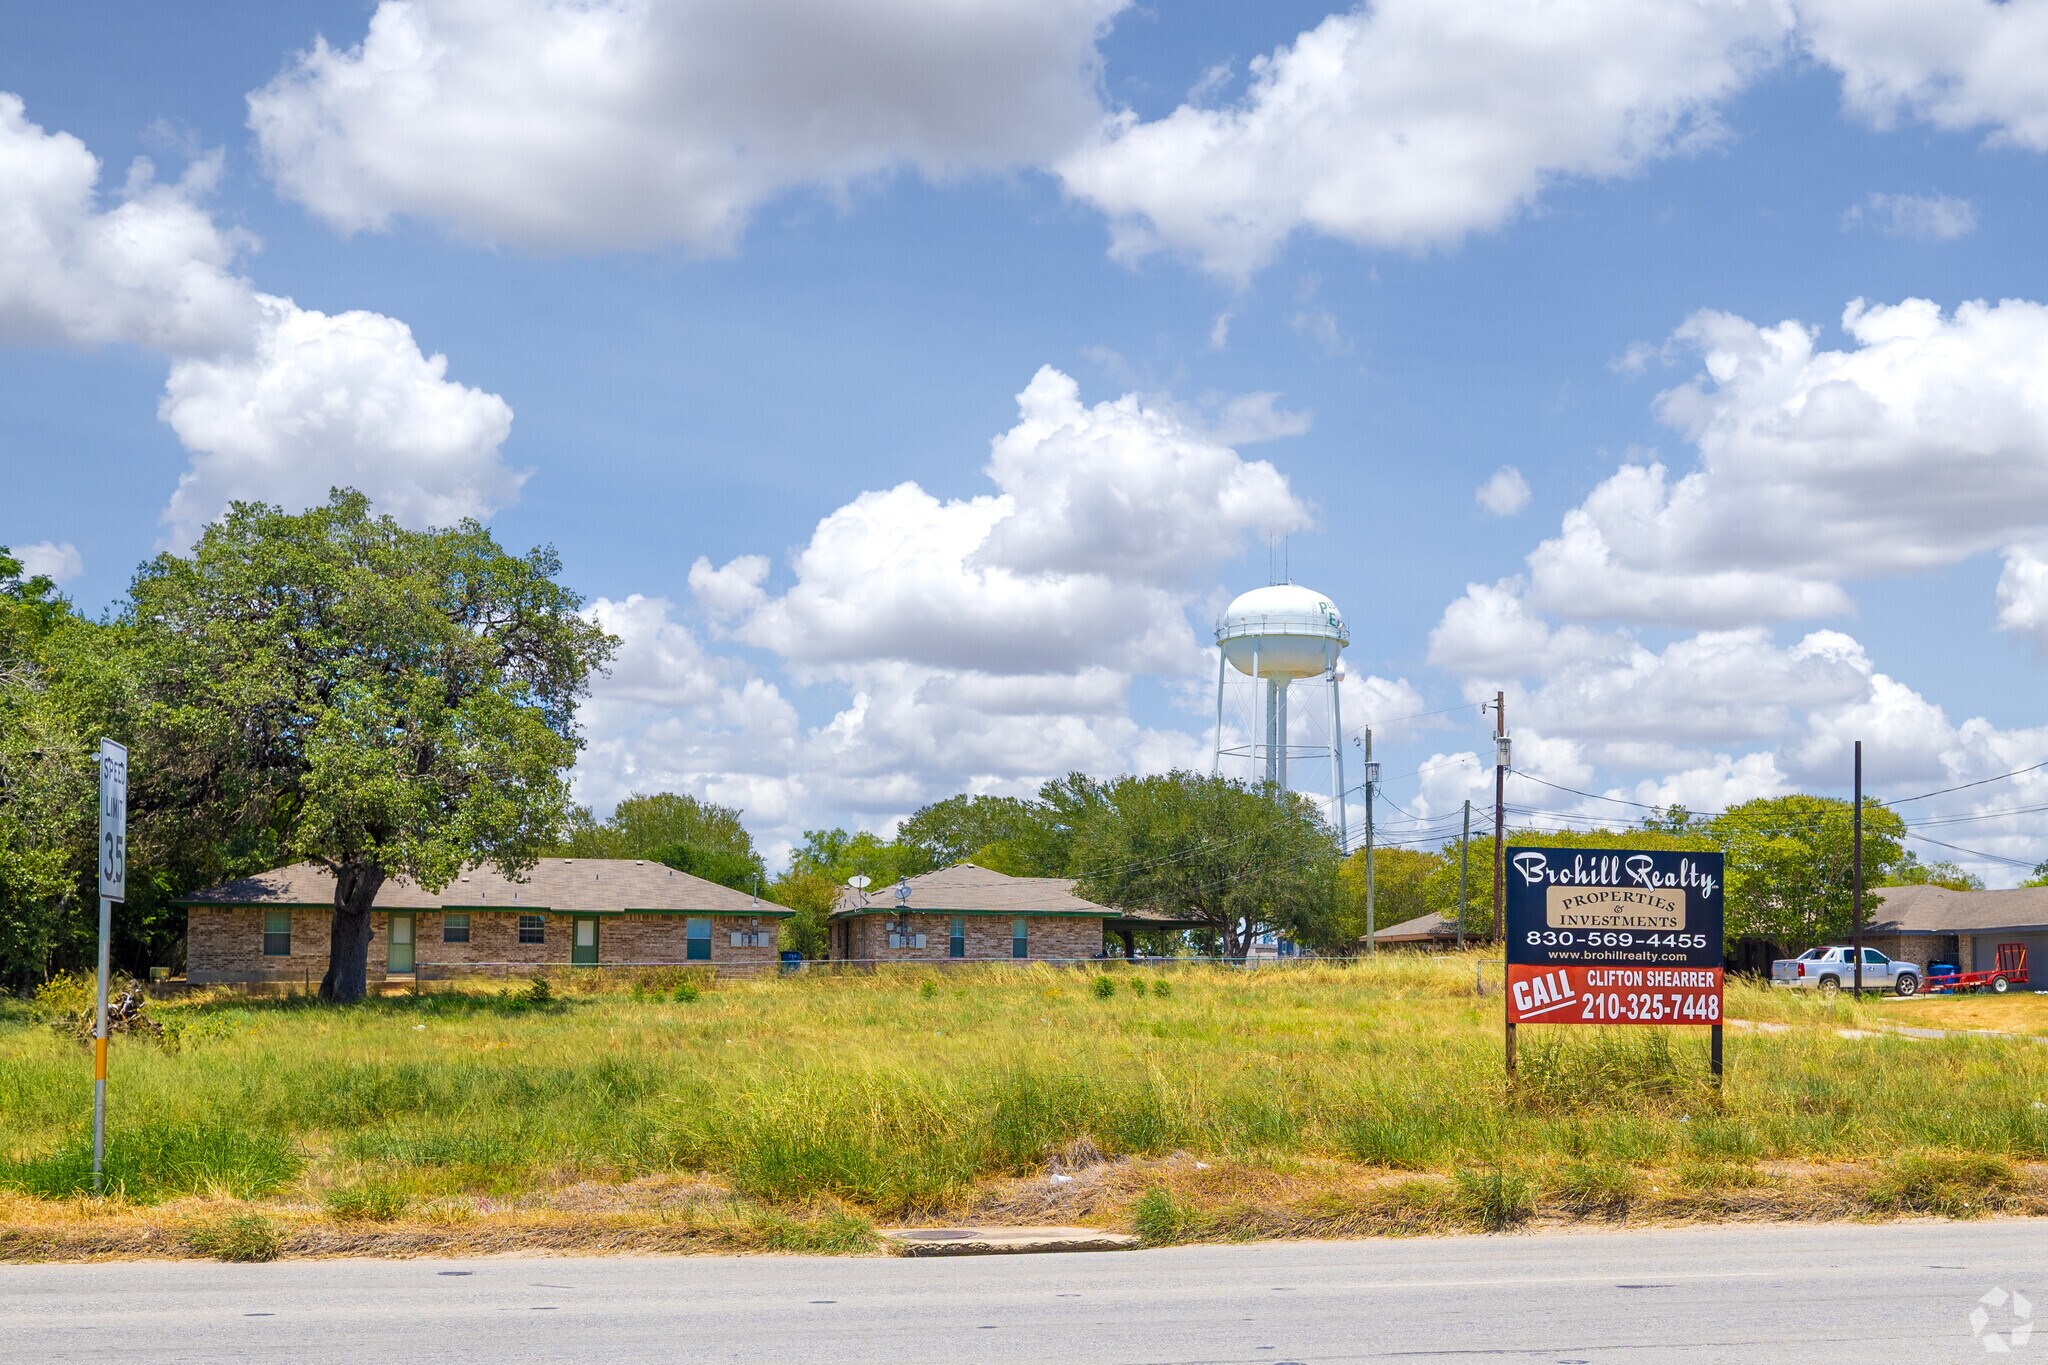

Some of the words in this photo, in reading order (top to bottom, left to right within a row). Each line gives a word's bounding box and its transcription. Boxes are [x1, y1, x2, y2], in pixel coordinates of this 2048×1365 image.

[104, 757, 126, 785] SPEED
[106, 795, 123, 821] LIMIT
[104, 831, 123, 884] 35
[1513, 852, 1621, 887] Brohill
[1625, 854, 1716, 899] Realty
[1562, 891, 1676, 912] PROPERTIES
[1613, 905, 1624, 914] &
[1560, 915, 1677, 928] INVESTMENTS
[1526, 931, 1707, 948] 830-569-4455
[1548, 950, 1687, 962] www.brohillrealty.com
[1512, 969, 1576, 1011] CALL
[1587, 970, 1643, 986] CLIFTON
[1647, 971, 1714, 987] SHEARRER
[1581, 993, 1719, 1020] 210-325-7448
